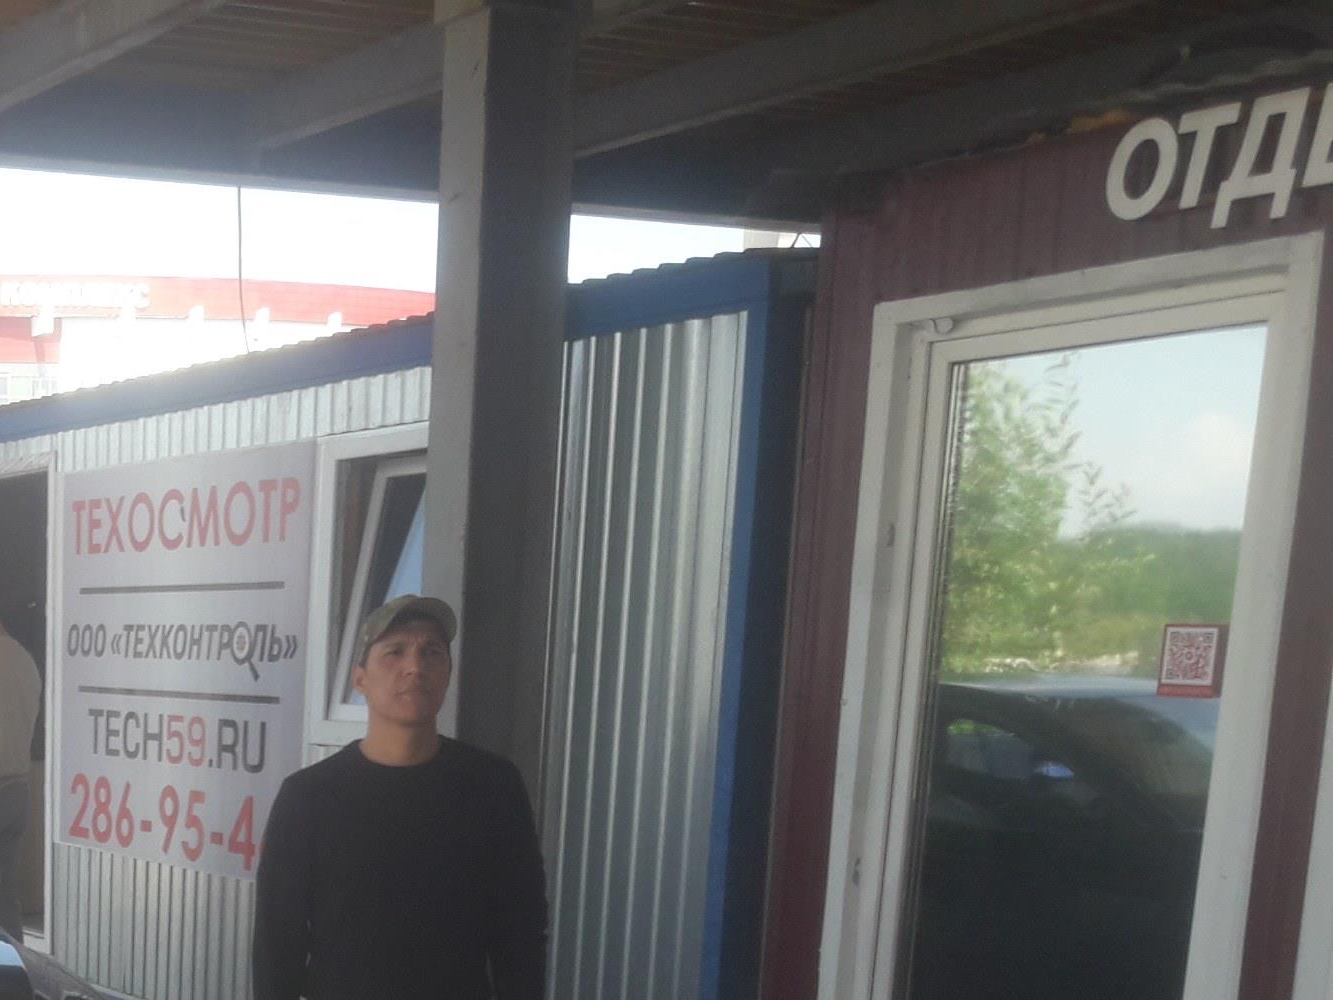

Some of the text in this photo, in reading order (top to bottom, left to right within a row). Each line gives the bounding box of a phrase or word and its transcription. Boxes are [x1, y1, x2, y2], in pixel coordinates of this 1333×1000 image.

[72, 477, 301, 555] ТЕХОСМОТР
[68, 623, 106, 658] ООО
[88, 708, 266, 774] TECH59.RU
[69, 773, 265, 872] 286-95-4
